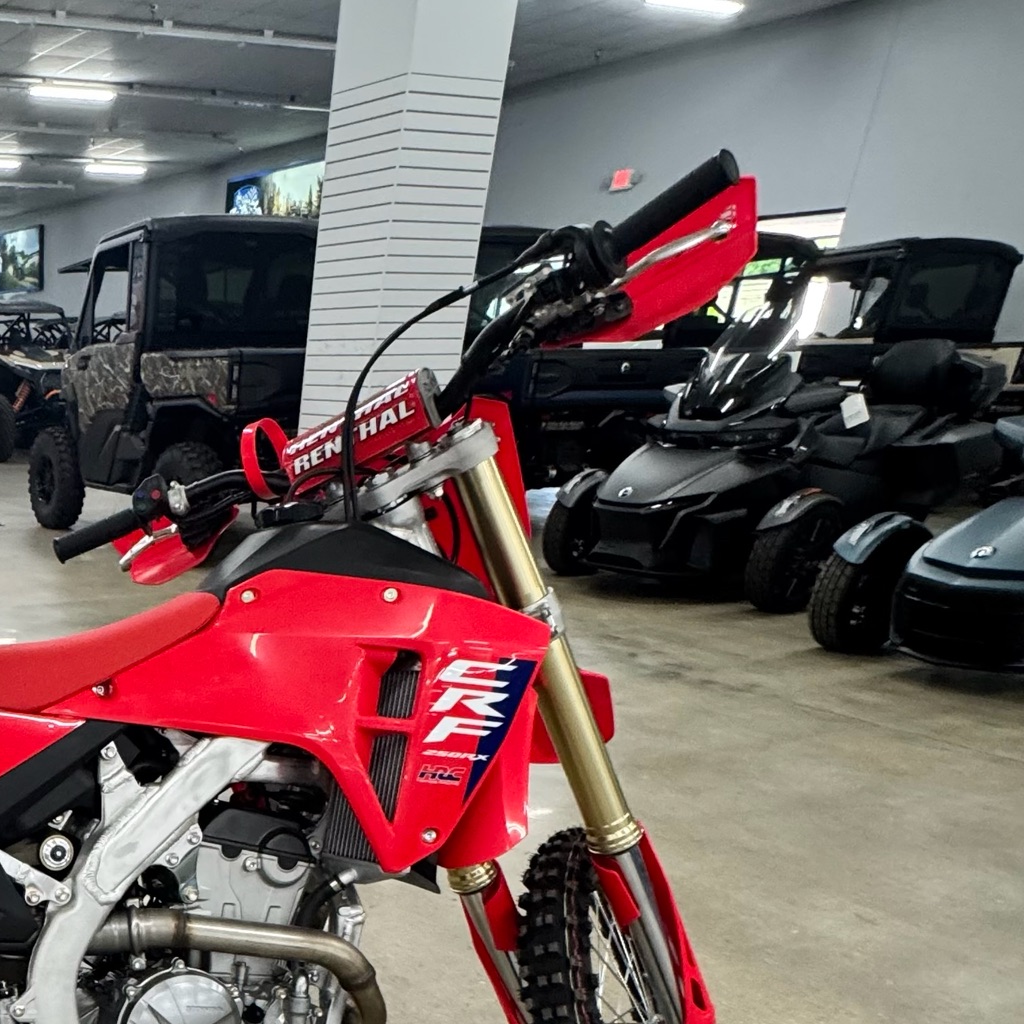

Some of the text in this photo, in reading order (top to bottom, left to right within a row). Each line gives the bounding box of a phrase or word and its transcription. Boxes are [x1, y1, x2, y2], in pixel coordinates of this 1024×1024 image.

[293, 400, 416, 475] RENHAL
[422, 659, 519, 744] CRF
[417, 763, 467, 782] HRC
[421, 748, 491, 762] 250RX
